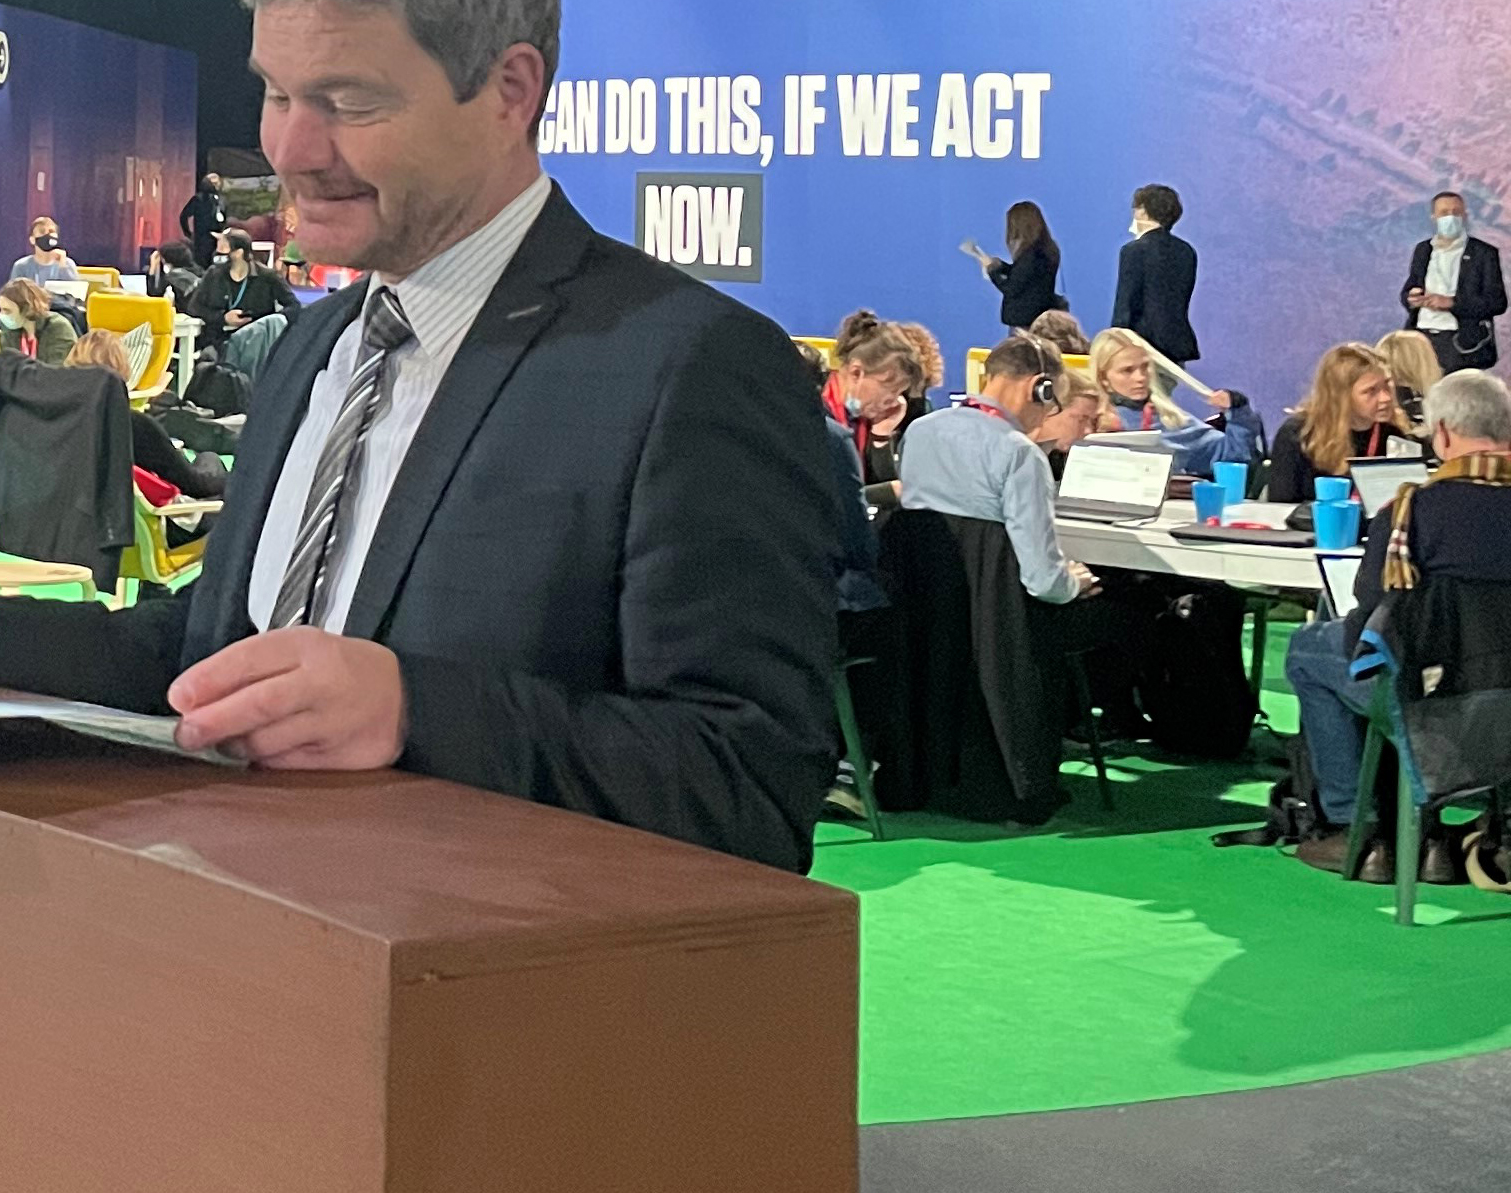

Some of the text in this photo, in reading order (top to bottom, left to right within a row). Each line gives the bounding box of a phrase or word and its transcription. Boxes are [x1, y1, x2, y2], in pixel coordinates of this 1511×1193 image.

[605, 77, 657, 155] DO
[664, 74, 774, 168] THIS,
[784, 74, 826, 156] IF
[836, 73, 921, 157] WE
[930, 72, 1051, 159] ACT
[644, 184, 752, 267] NOW.
